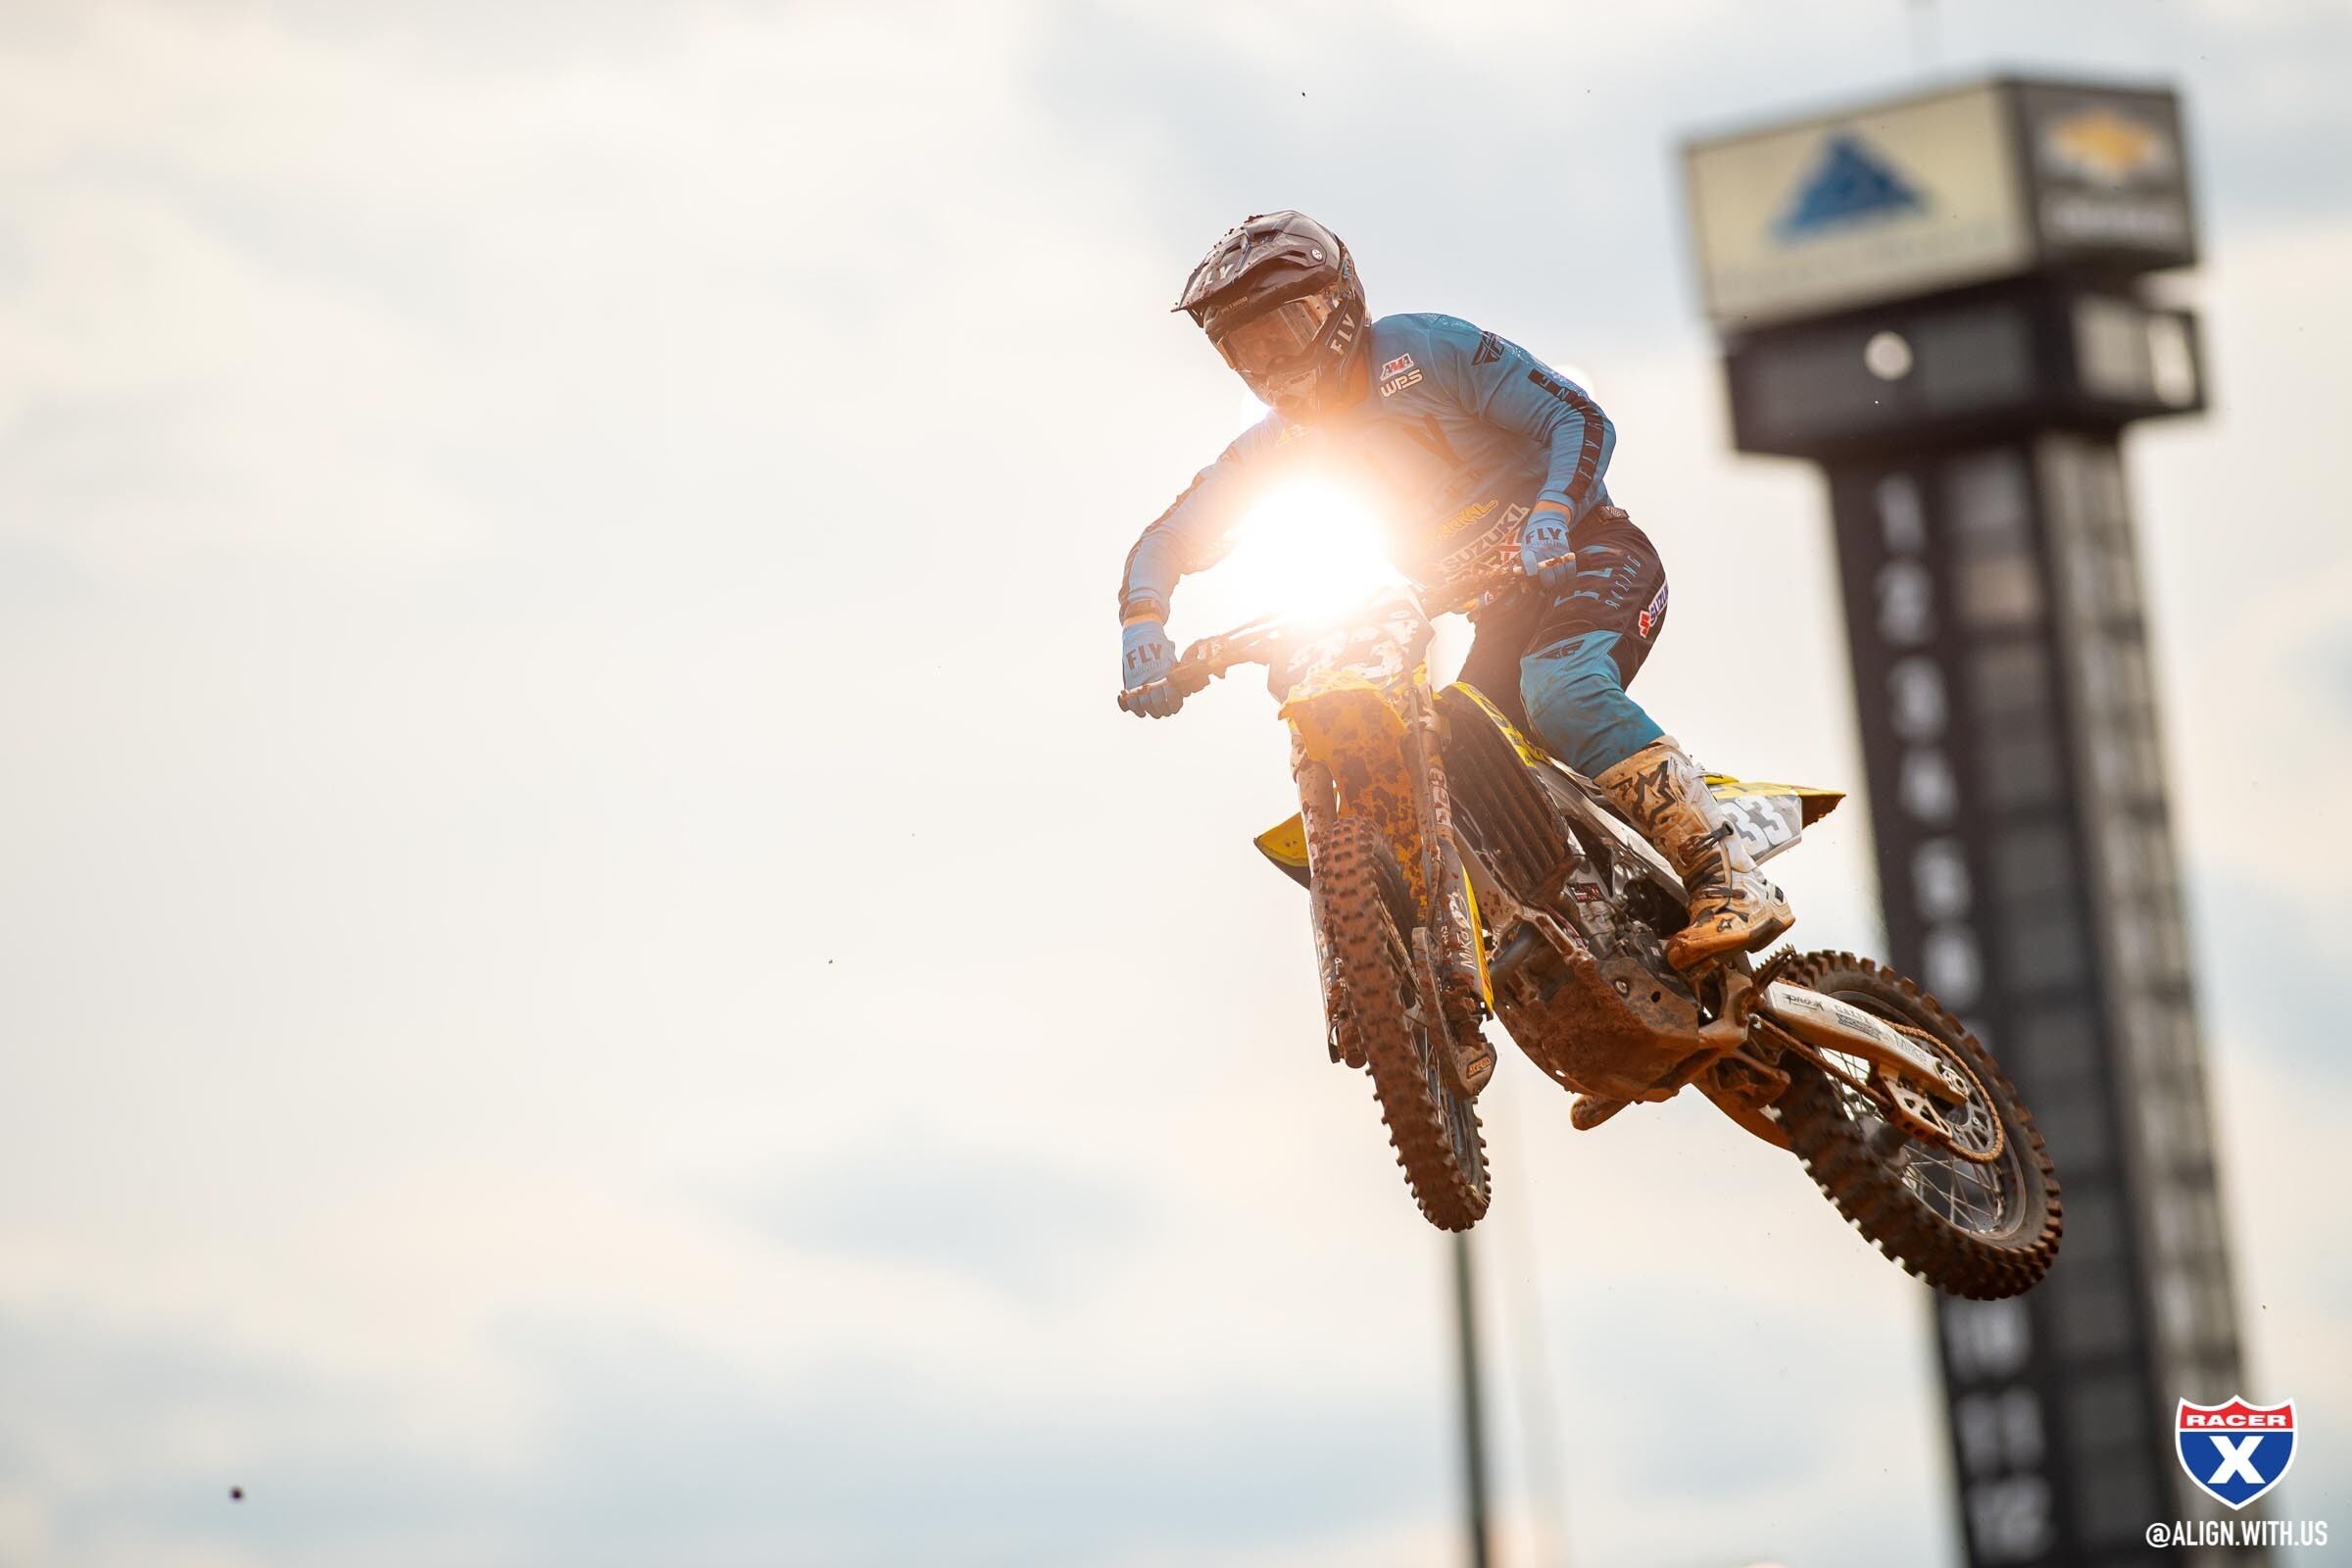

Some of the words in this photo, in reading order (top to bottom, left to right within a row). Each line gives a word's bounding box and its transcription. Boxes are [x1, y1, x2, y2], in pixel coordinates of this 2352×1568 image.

[1330, 313, 1355, 356] FLY
[1381, 354, 1413, 379] AMA
[1380, 368, 1423, 397] WPS
[1442, 503, 1529, 576] SUZUKI
[1525, 526, 1562, 545] FLY
[1126, 642, 1162, 671] FLY
[1717, 796, 1793, 856] 33
